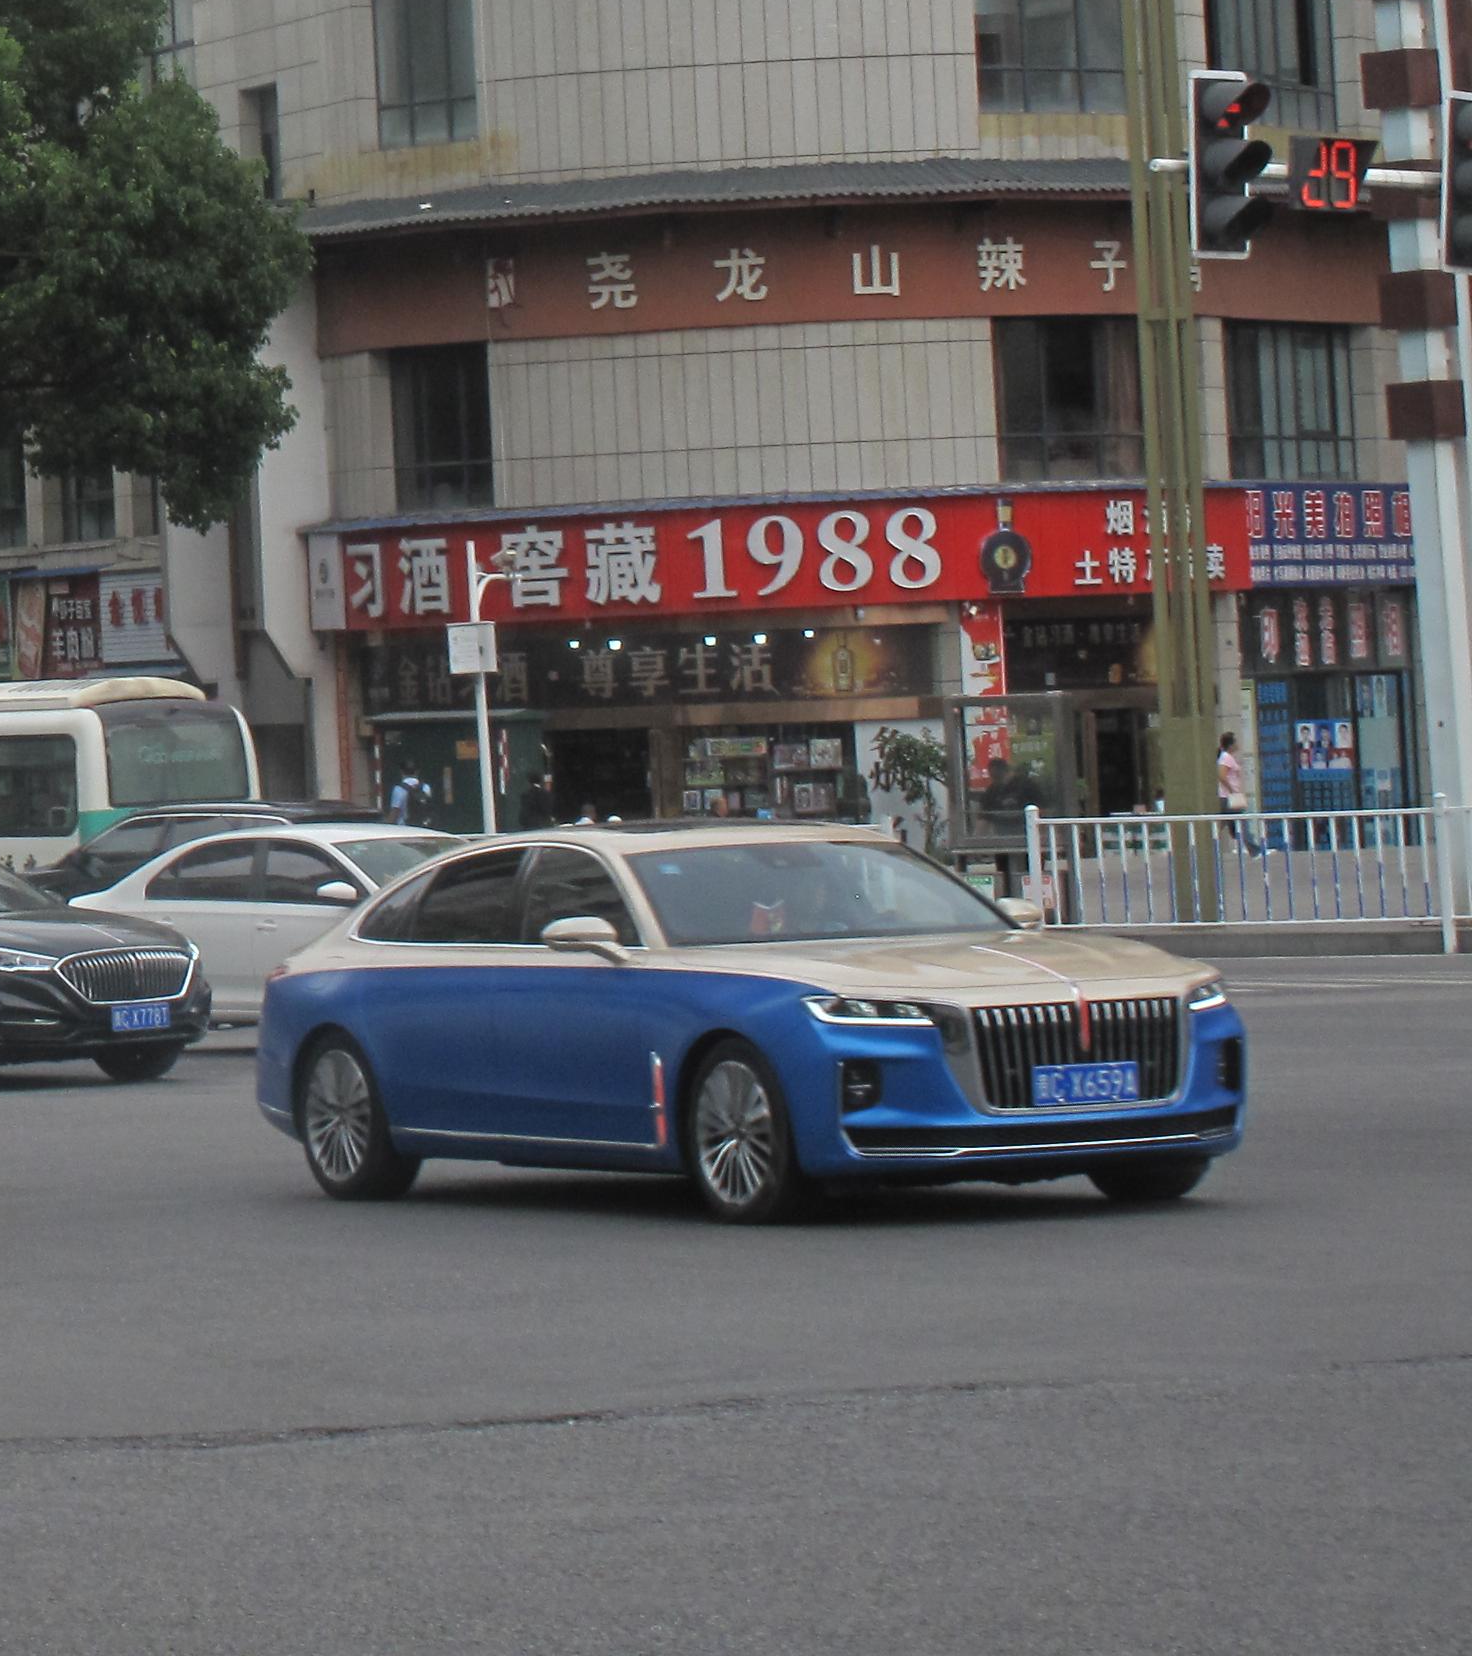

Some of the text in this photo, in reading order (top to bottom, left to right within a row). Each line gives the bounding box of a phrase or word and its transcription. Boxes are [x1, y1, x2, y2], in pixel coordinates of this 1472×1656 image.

[587, 238, 1202, 310] 尧龙山辣子
